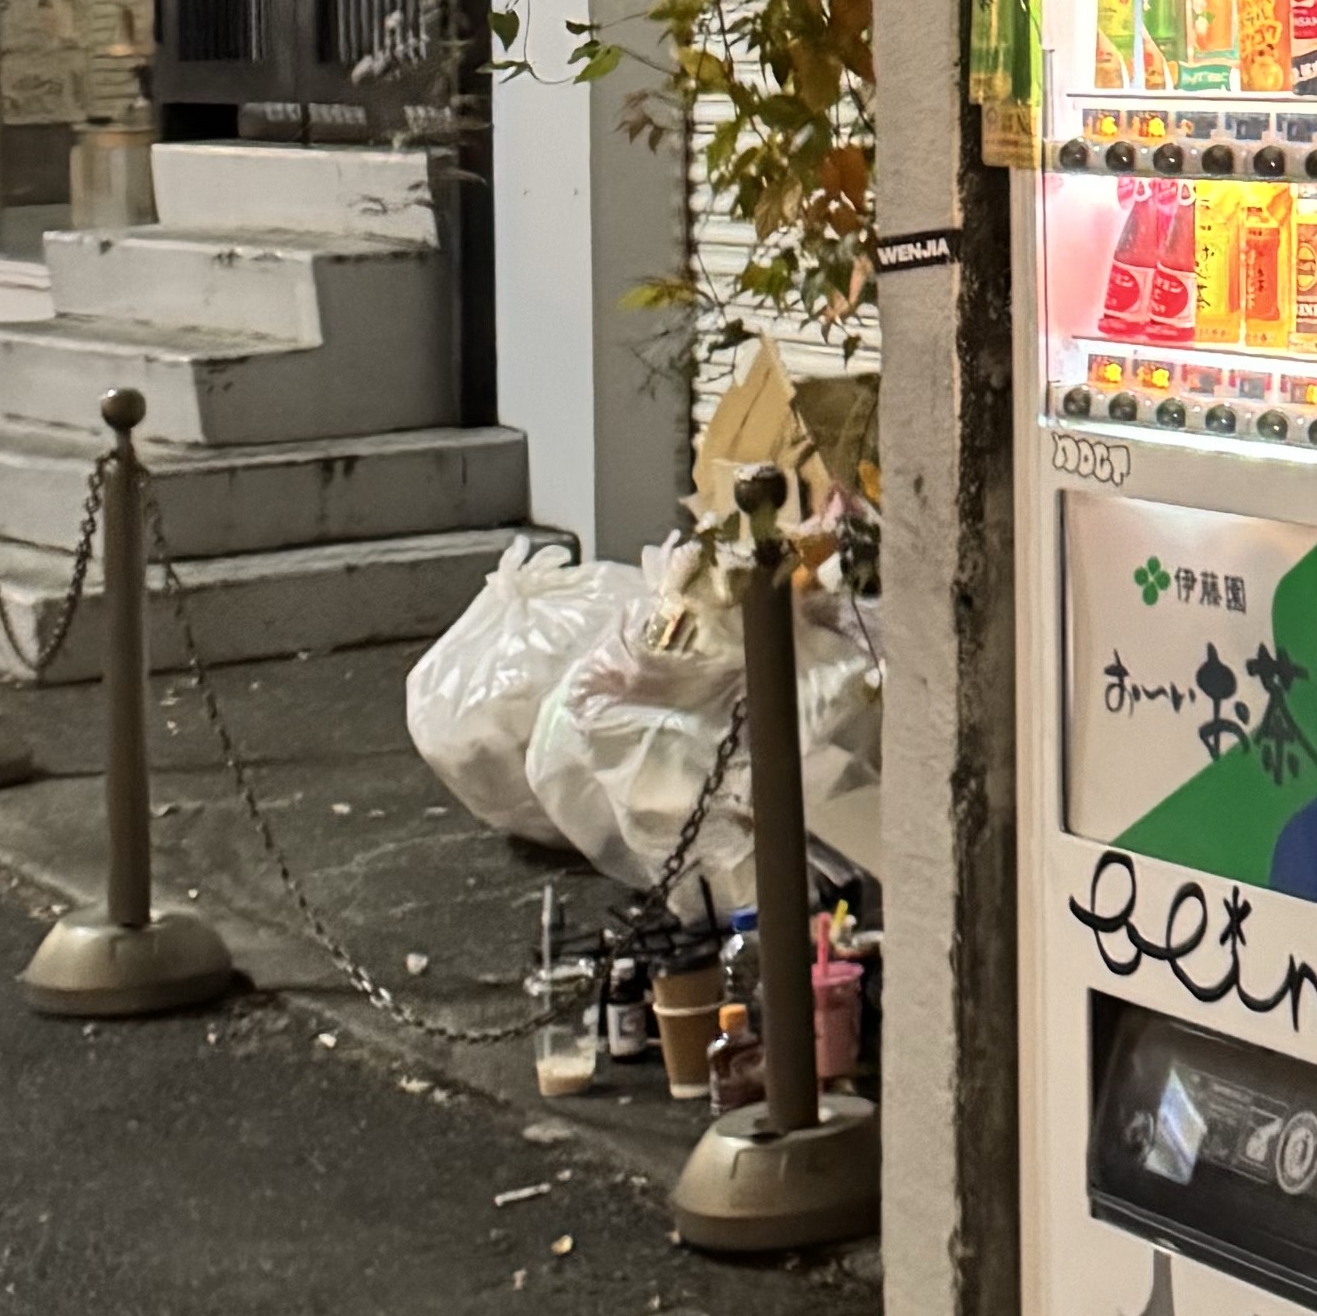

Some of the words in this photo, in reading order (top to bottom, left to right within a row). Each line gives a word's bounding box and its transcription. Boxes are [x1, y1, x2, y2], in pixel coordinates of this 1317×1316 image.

[877, 237, 950, 266] WENJIA
[1173, 566, 1247, 614] 伊藤園
